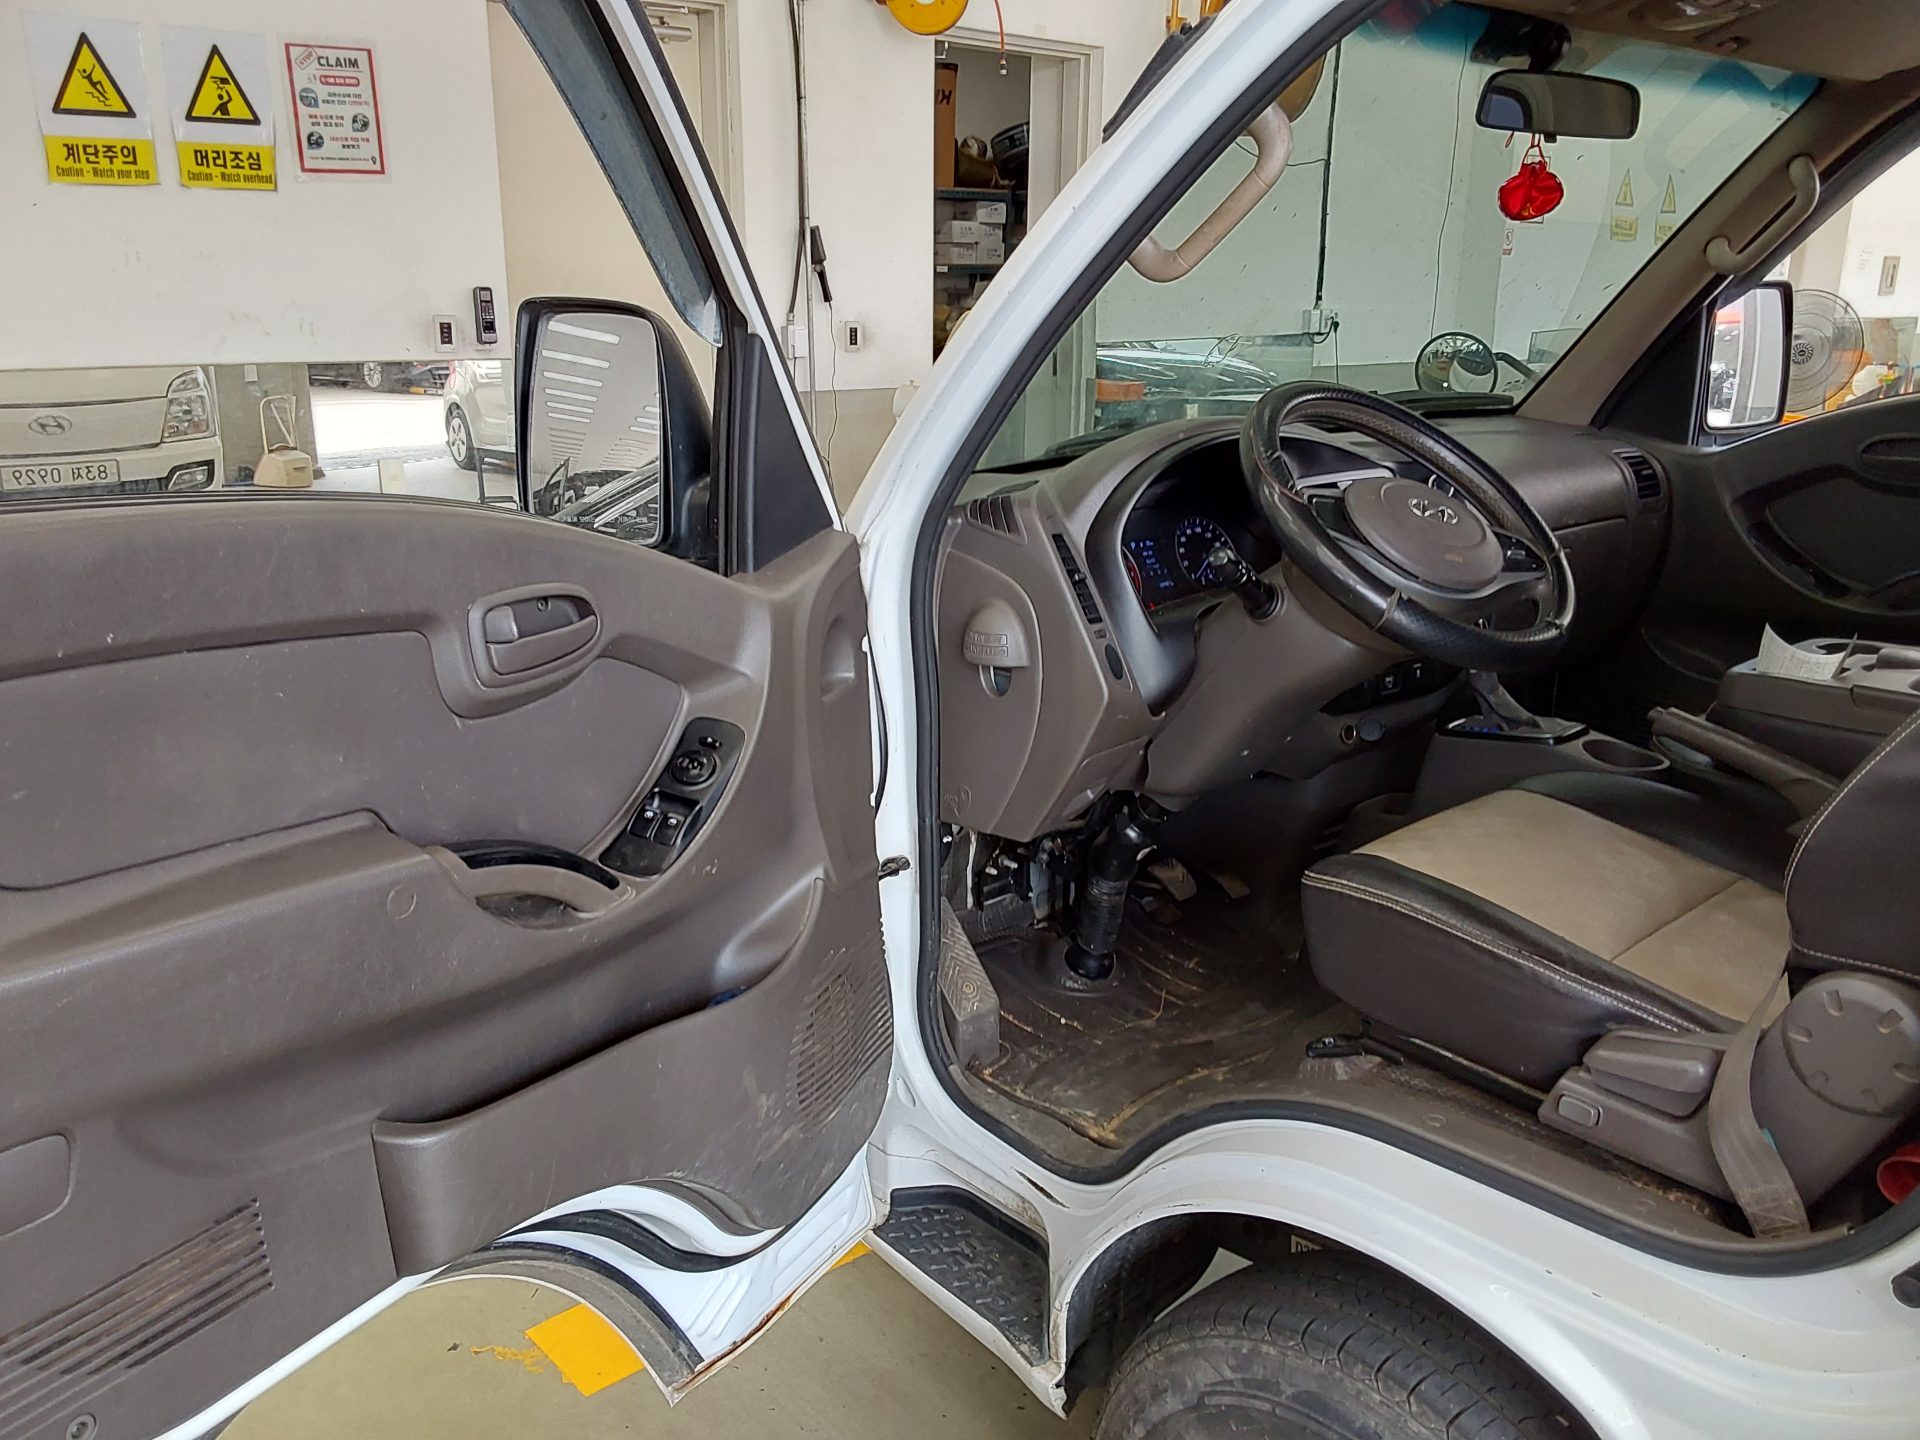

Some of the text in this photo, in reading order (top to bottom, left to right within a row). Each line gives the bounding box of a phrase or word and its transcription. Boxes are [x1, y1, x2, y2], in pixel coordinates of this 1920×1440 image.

[317, 55, 360, 70] CLAIM
[62, 143, 138, 166] 계단주의
[193, 149, 262, 171] 머리조심
[55, 165, 84, 178] Caution
[92, 166, 115, 179] Watch
[117, 168, 132, 180] your
[135, 168, 150, 180] step
[187, 169, 213, 182] Caution
[220, 171, 241, 183] Watch
[243, 172, 273, 185] overhead
